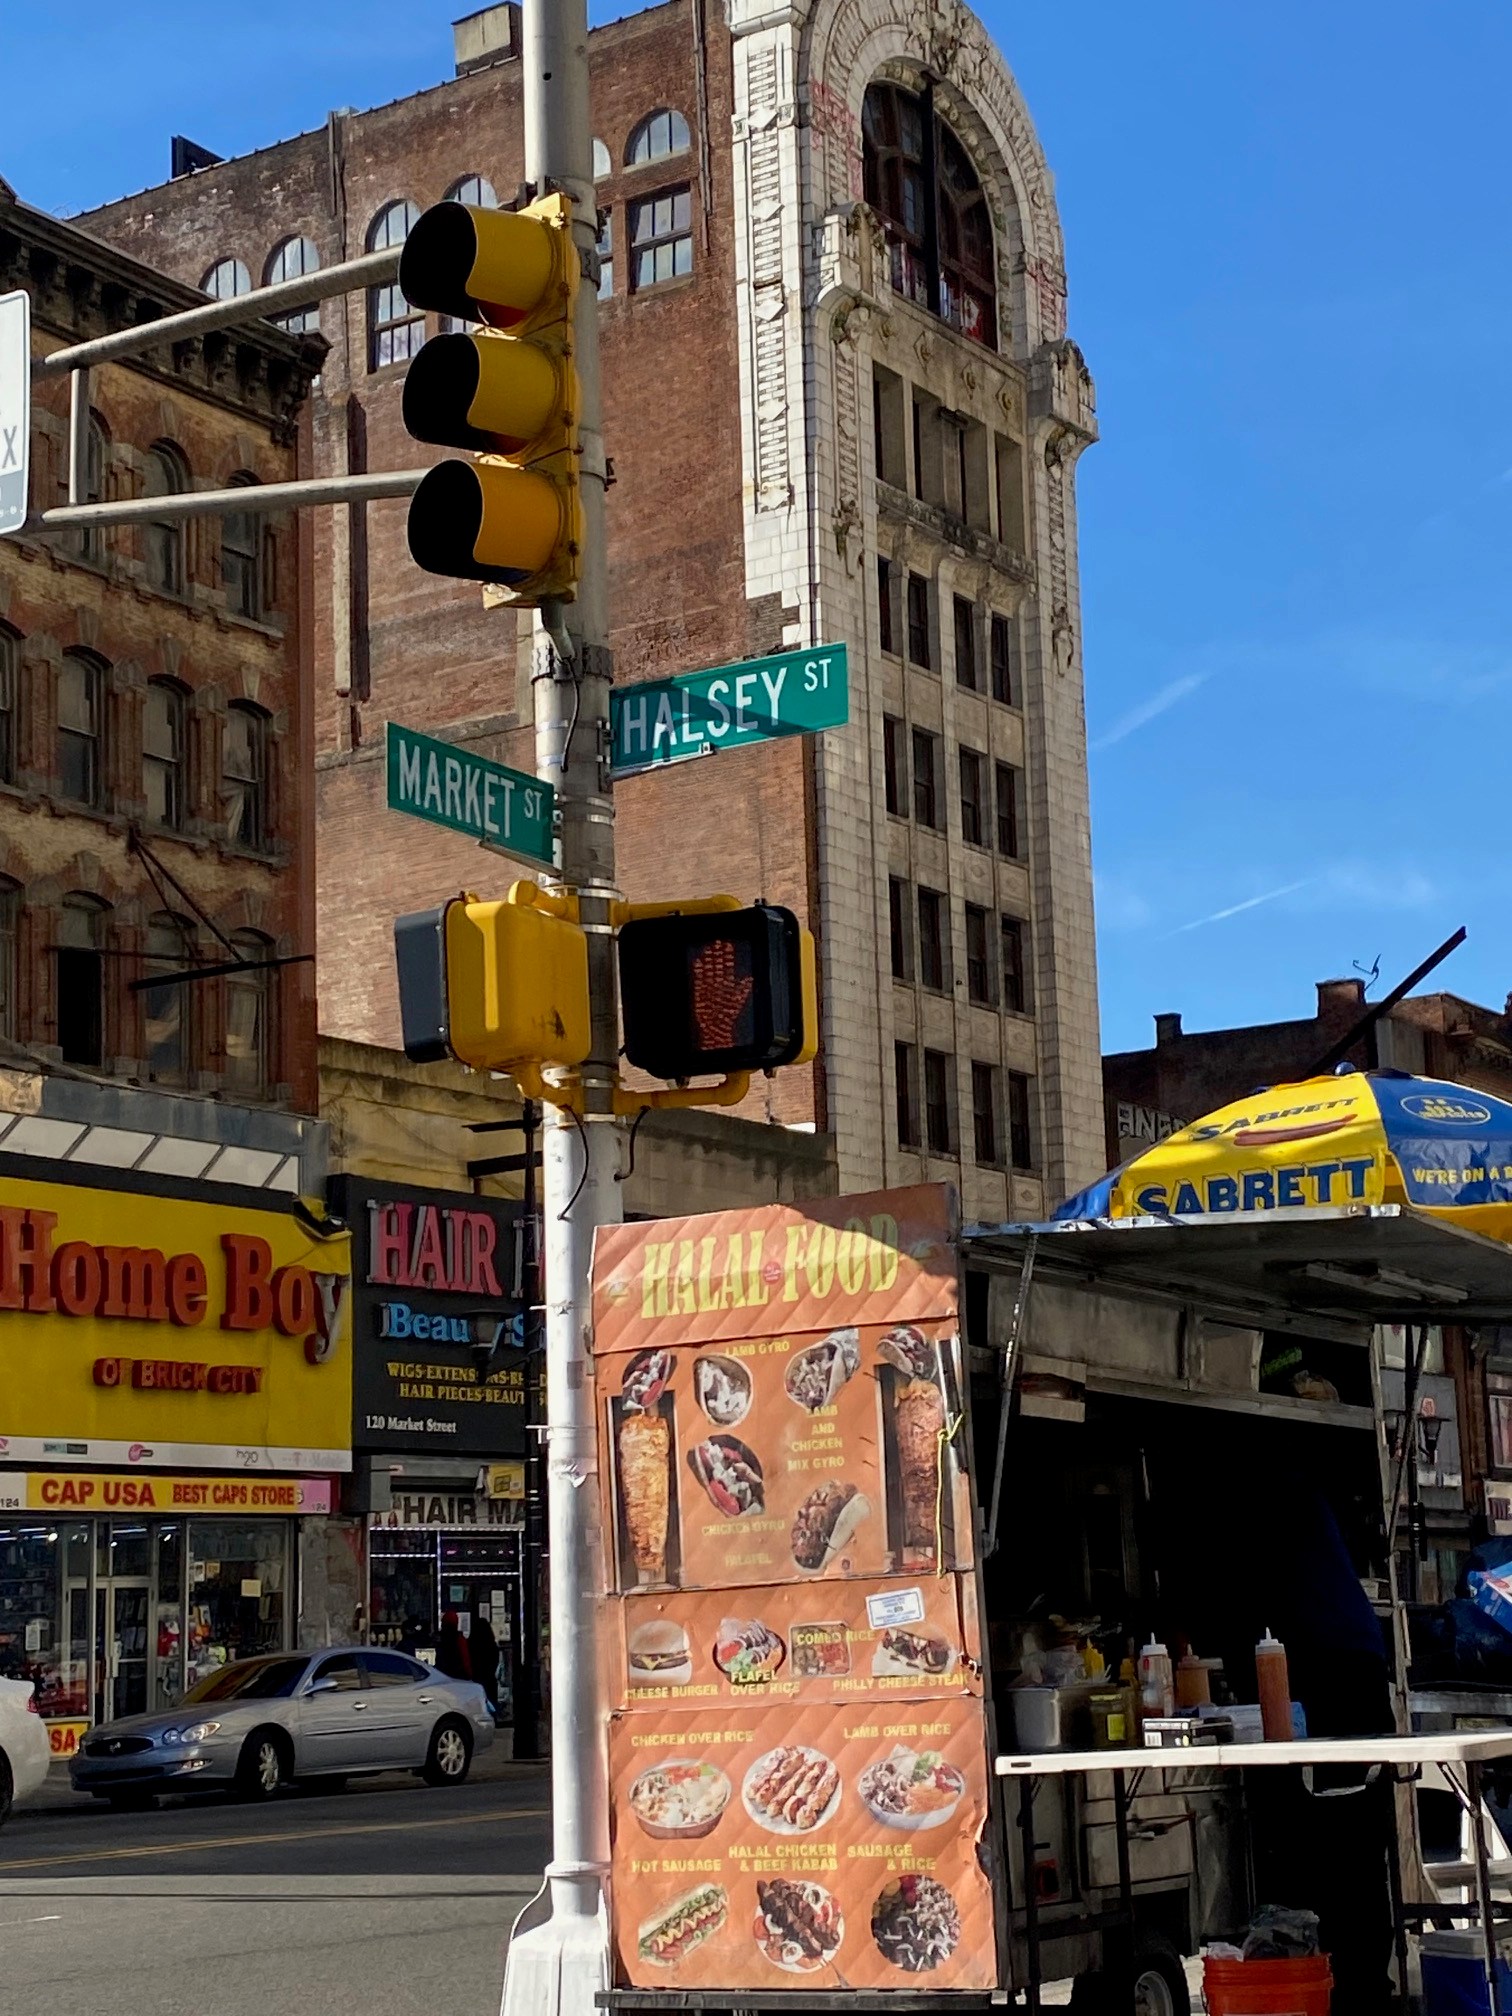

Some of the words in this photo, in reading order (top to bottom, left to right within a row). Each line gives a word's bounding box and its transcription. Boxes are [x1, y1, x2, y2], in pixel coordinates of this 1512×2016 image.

[623, 668, 788, 755] HALSEY
[804, 658, 832, 692] ST
[399, 740, 516, 838] MARKET
[524, 790, 543, 822] ST
[1192, 1098, 1358, 1141] SABRETT
[1462, 1168, 1484, 1182] ON
[1489, 1166, 1500, 1180] A
[1133, 1156, 1375, 1213] SABRETT
[367, 1200, 502, 1296] HAIR
[641, 1230, 769, 1319] HALAL
[782, 1213, 898, 1302] FOOD
[0, 1206, 207, 1327] Home
[220, 1233, 346, 1365] Boy
[726, 1344, 755, 1357] LAMB
[759, 1341, 790, 1355] GYRO
[132, 1360, 207, 1392] BRICK
[208, 1365, 263, 1394] CITY
[400, 1383, 435, 1399] HAIR
[366, 1415, 386, 1430] 120
[388, 1416, 424, 1432] Market
[427, 1418, 458, 1433] Street
[811, 1423, 835, 1435] AND
[791, 1438, 843, 1452] CHICKEN
[787, 1459, 809, 1471] MIX
[813, 1456, 845, 1469] GYRO
[41, 1479, 95, 1504] CAP
[103, 1481, 155, 1507] USA
[172, 1483, 207, 1504] BEST
[213, 1484, 247, 1505] CAPS
[251, 1485, 295, 1506] STORE
[403, 1496, 477, 1525] HAIR
[846, 1630, 876, 1643] RICE
[731, 1670, 777, 1682] FLAFEL
[833, 1678, 876, 1692] PHILLY
[878, 1676, 926, 1689] CHEESE
[625, 1687, 669, 1700] CHEESE
[672, 1684, 718, 1697] BURGER
[730, 1684, 767, 1696] OVER
[769, 1682, 799, 1695] RICE
[631, 1734, 686, 1747] CHICKEN
[688, 1731, 721, 1744] OVER
[724, 1730, 754, 1743] RICE
[843, 1726, 879, 1739] LAMB
[883, 1724, 918, 1737] OVER
[921, 1723, 951, 1736] RICE
[728, 1846, 771, 1858] HALAL
[776, 1844, 837, 1857] CHICKEN
[847, 1843, 913, 1858] SAUSAGE
[631, 1860, 658, 1873] HOT
[662, 1858, 722, 1873] SAUSAGE
[739, 1859, 750, 1872] &
[754, 1859, 786, 1872] BEEF
[886, 1859, 898, 1871] &
[901, 1858, 936, 1871] RICE
